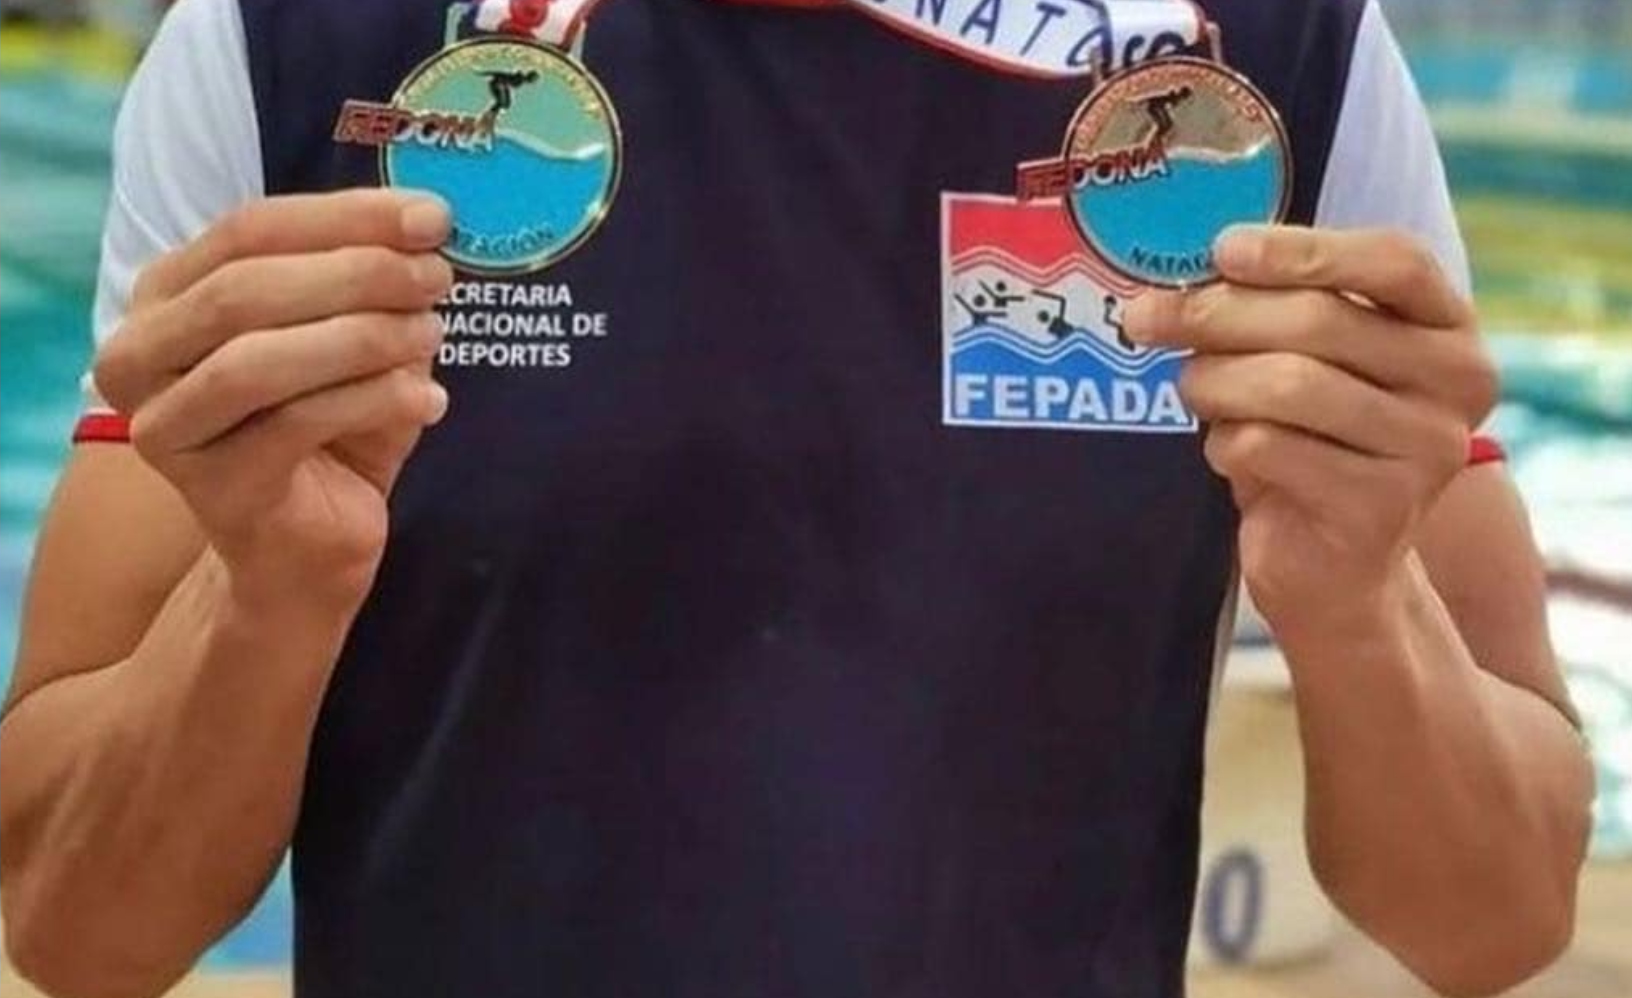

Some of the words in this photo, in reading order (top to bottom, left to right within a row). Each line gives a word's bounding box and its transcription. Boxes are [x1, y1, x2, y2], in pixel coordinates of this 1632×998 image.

[573, 314, 608, 337] DE
[439, 343, 572, 367] DEPORTES
[954, 373, 1189, 424] FEPADA
